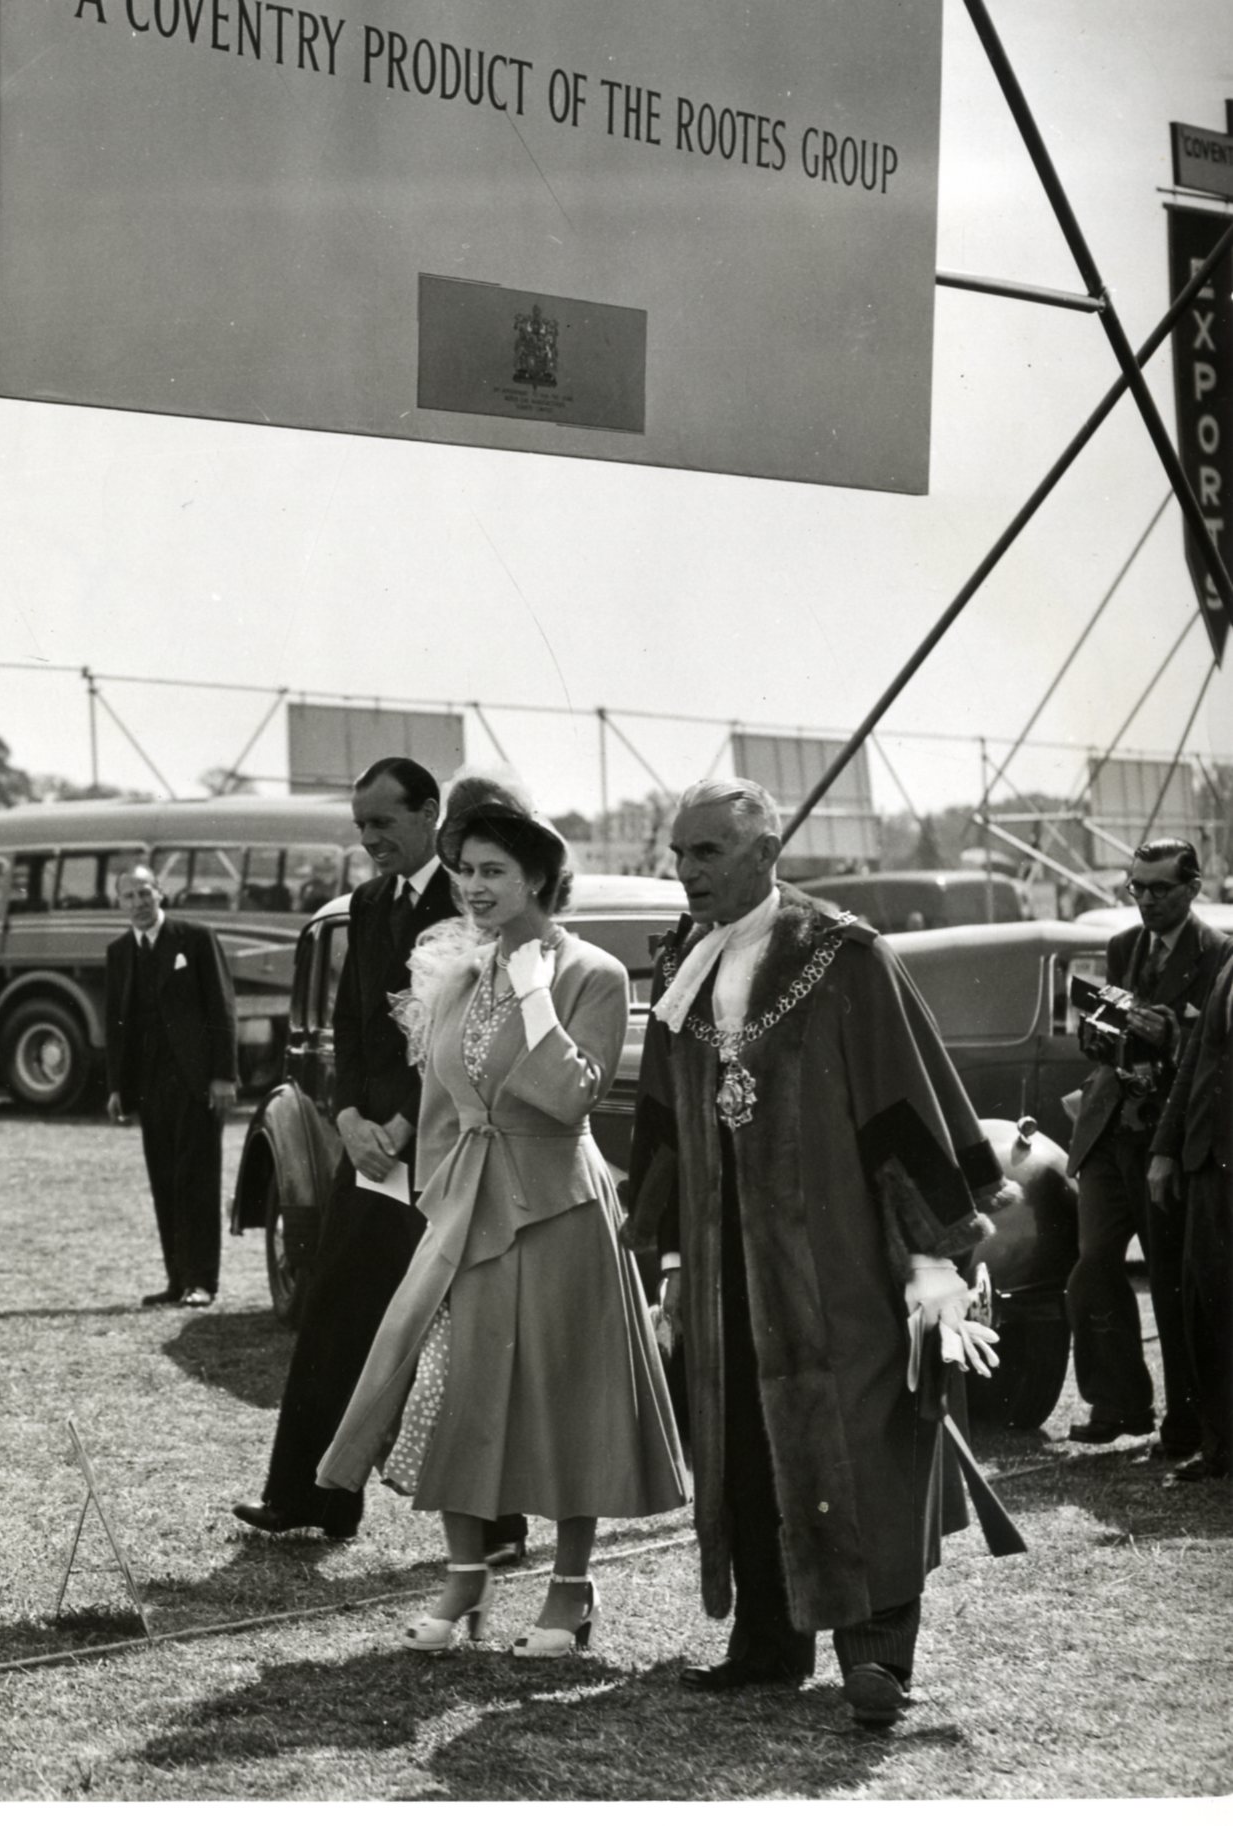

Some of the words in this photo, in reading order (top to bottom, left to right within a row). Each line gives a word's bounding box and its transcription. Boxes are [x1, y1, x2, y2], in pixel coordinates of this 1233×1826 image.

[363, 24, 533, 115] PRODUCT
[549, 68, 588, 127] OF
[600, 79, 662, 145] THE
[676, 97, 787, 171] ROOTES
[802, 127, 898, 194] GROUP
